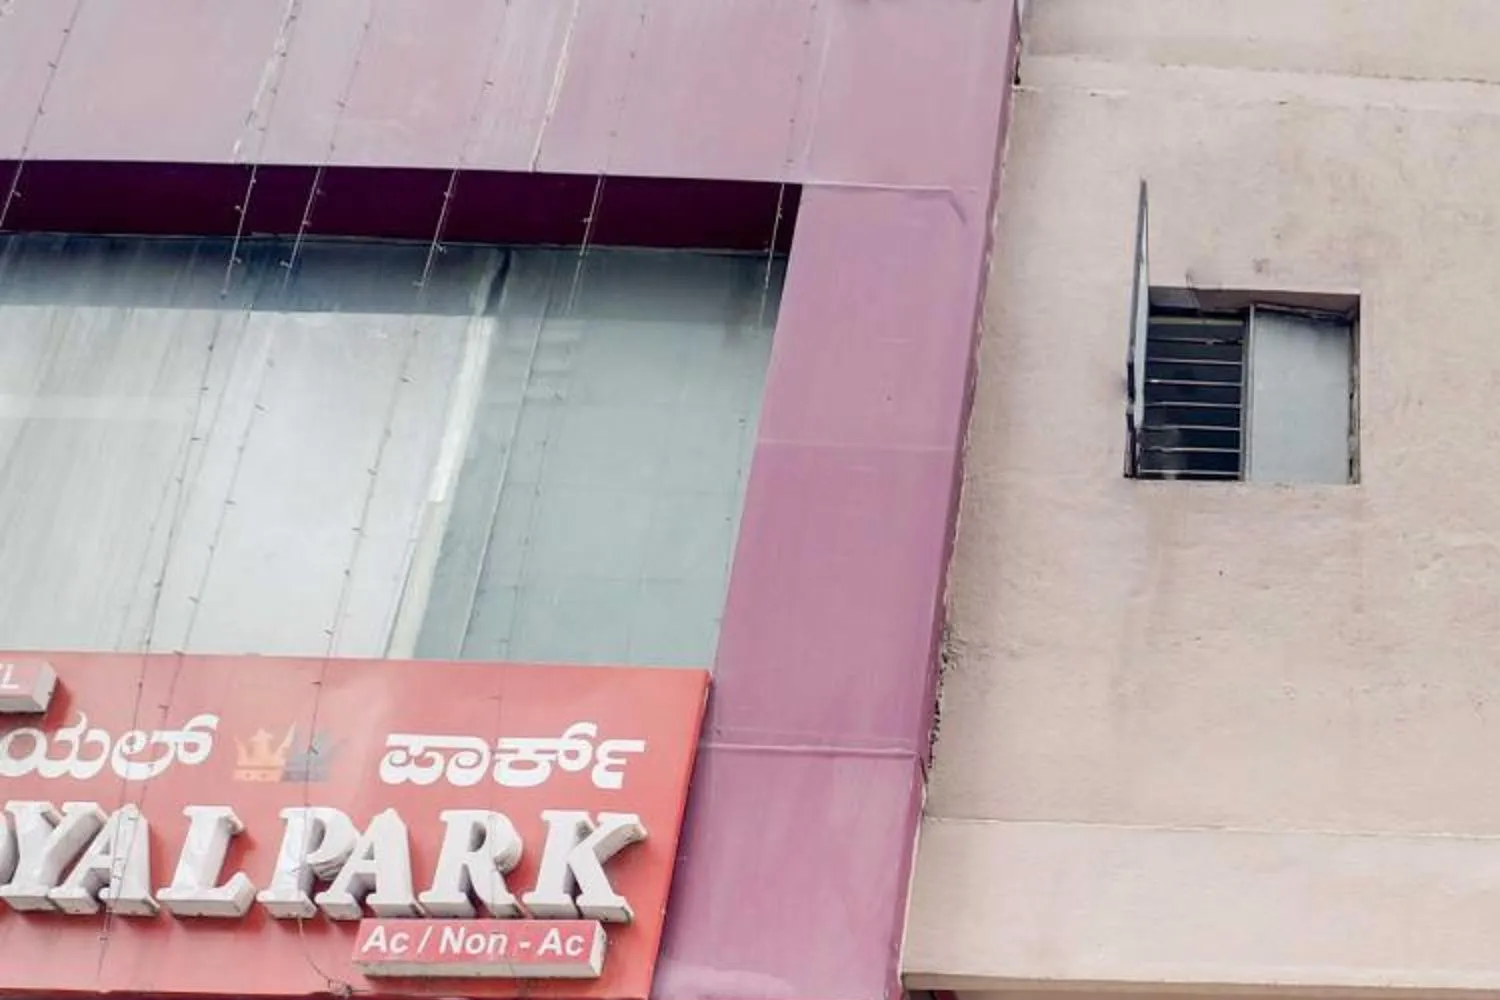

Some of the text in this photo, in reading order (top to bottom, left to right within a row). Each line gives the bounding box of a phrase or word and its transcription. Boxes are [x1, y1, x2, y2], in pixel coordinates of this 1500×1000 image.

[378, 721, 645, 789] ಪಾರ್ಕ್
[0, 800, 649, 922] YAL PARK
[362, 925, 410, 954] Ac
[439, 926, 508, 956] Non
[537, 928, 585, 956] Ac
